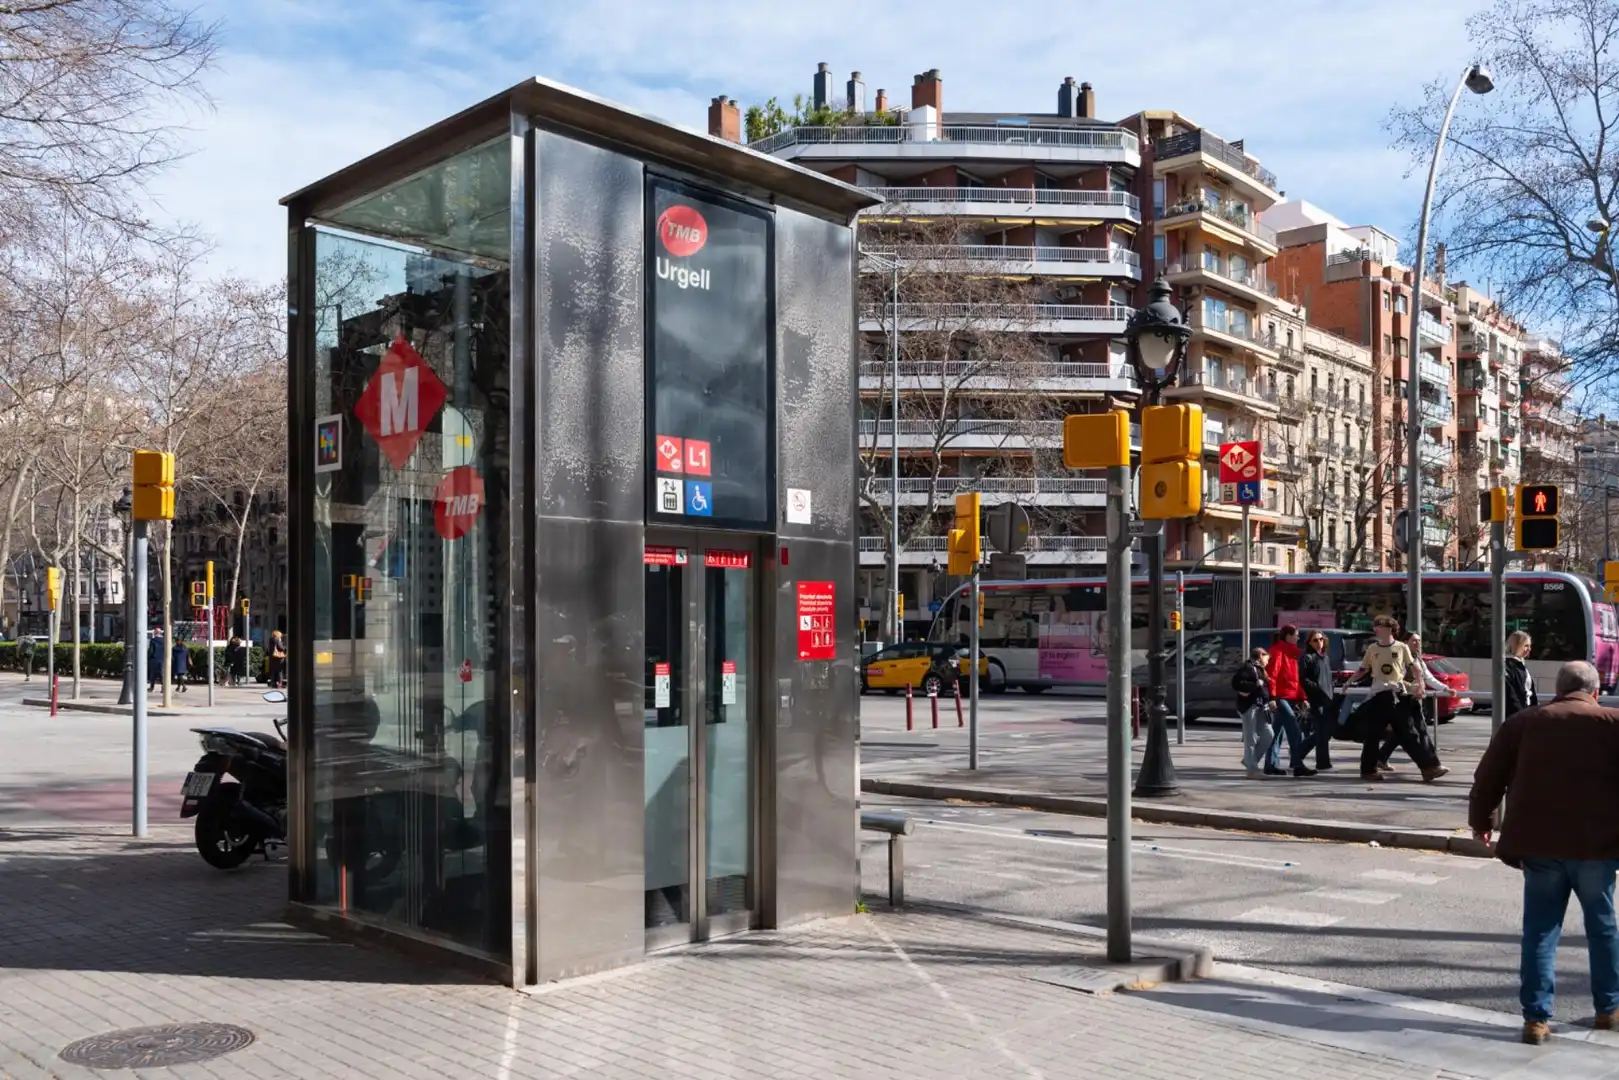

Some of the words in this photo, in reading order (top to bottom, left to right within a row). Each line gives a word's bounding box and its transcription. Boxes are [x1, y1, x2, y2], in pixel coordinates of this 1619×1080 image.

[668, 221, 701, 243] TMB
[656, 256, 710, 290] Urgell
[380, 366, 418, 436] M
[689, 447, 706, 468] L1
[1230, 451, 1243, 464] M
[445, 494, 479, 516] TMB
